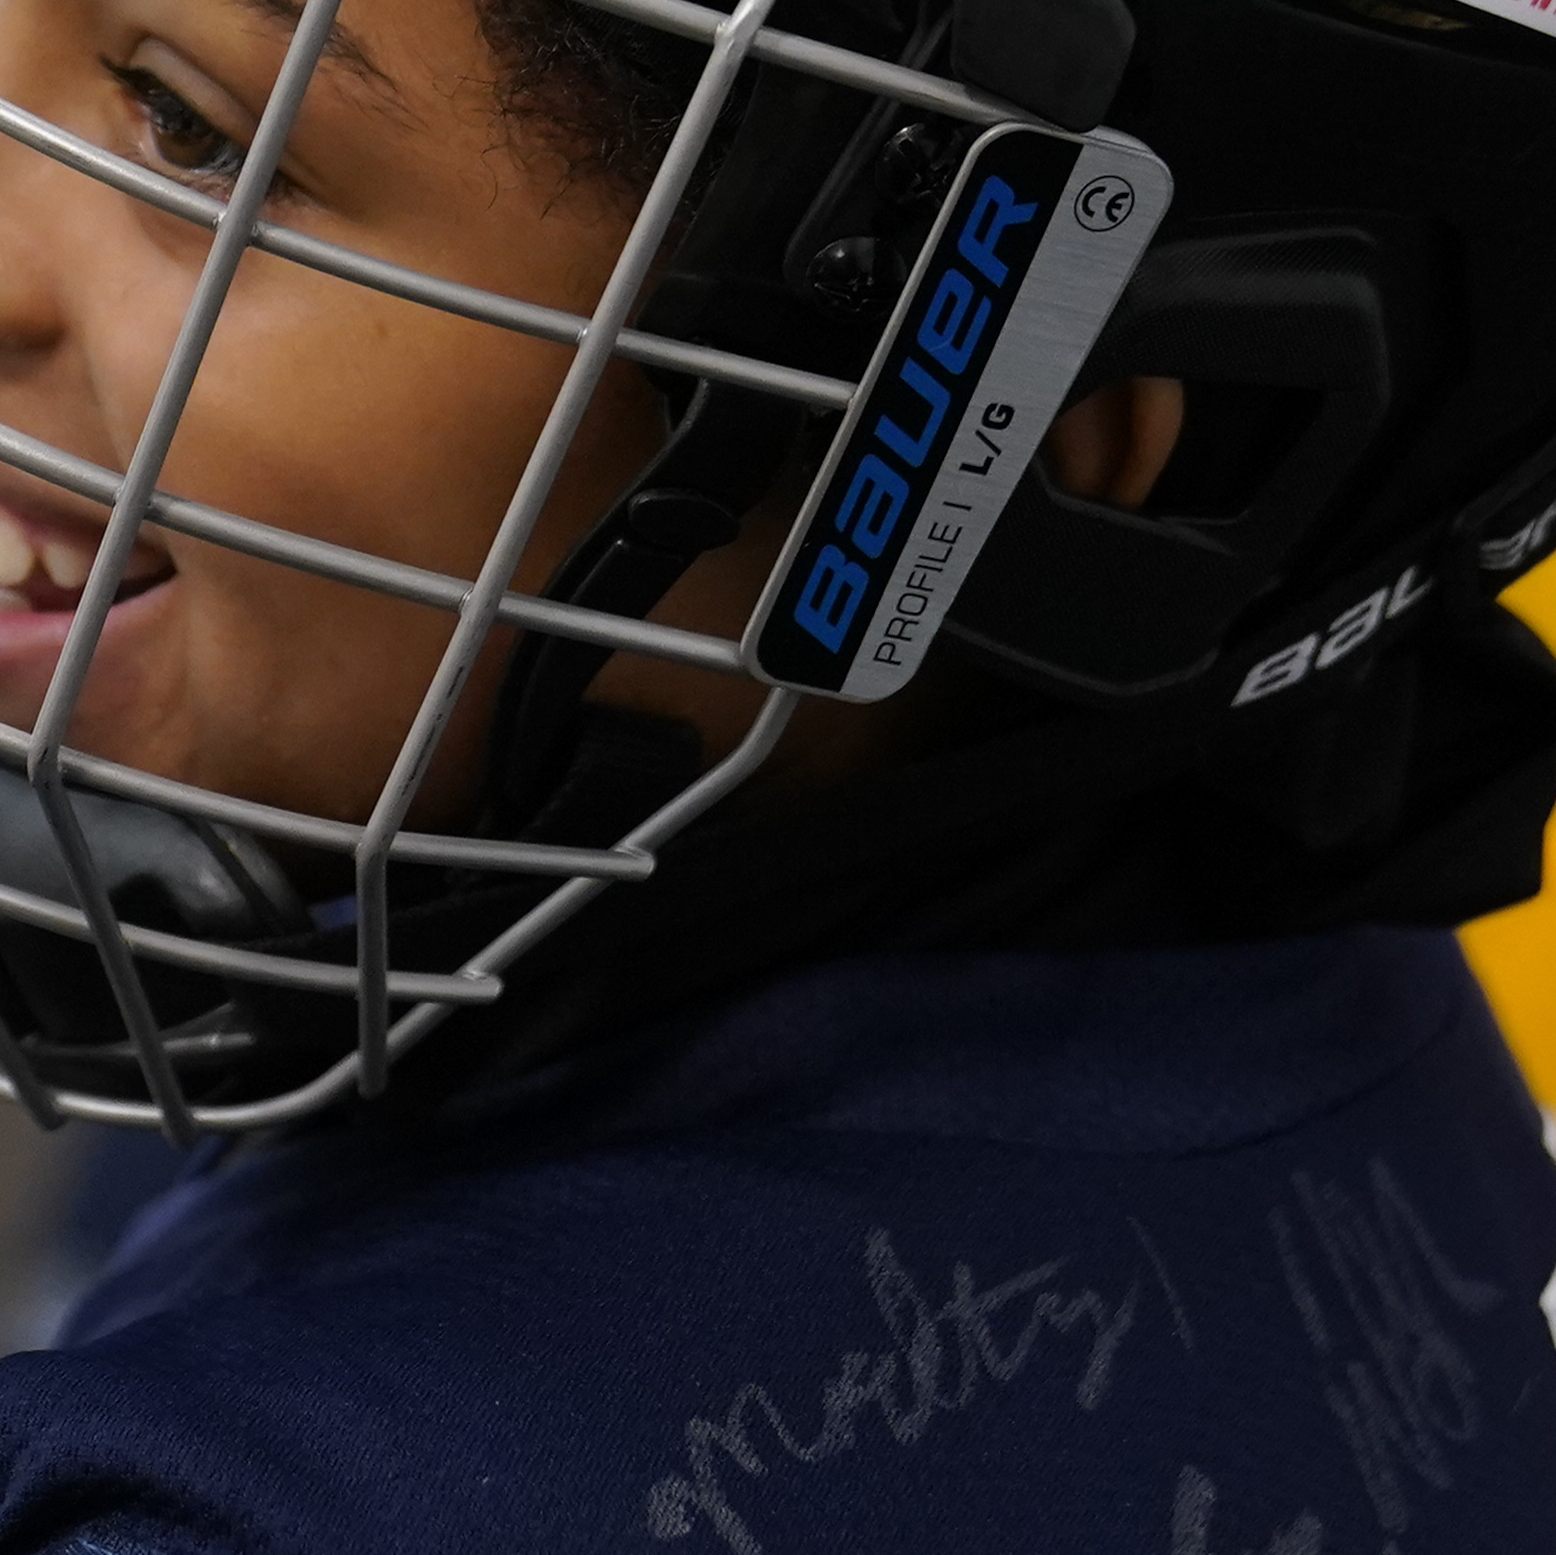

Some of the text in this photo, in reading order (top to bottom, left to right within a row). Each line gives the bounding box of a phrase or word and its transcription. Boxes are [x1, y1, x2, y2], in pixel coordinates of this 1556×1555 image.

[793, 175, 1039, 654] BAUER
[873, 522, 963, 666] PROFILE
[958, 402, 1016, 477] L/G
